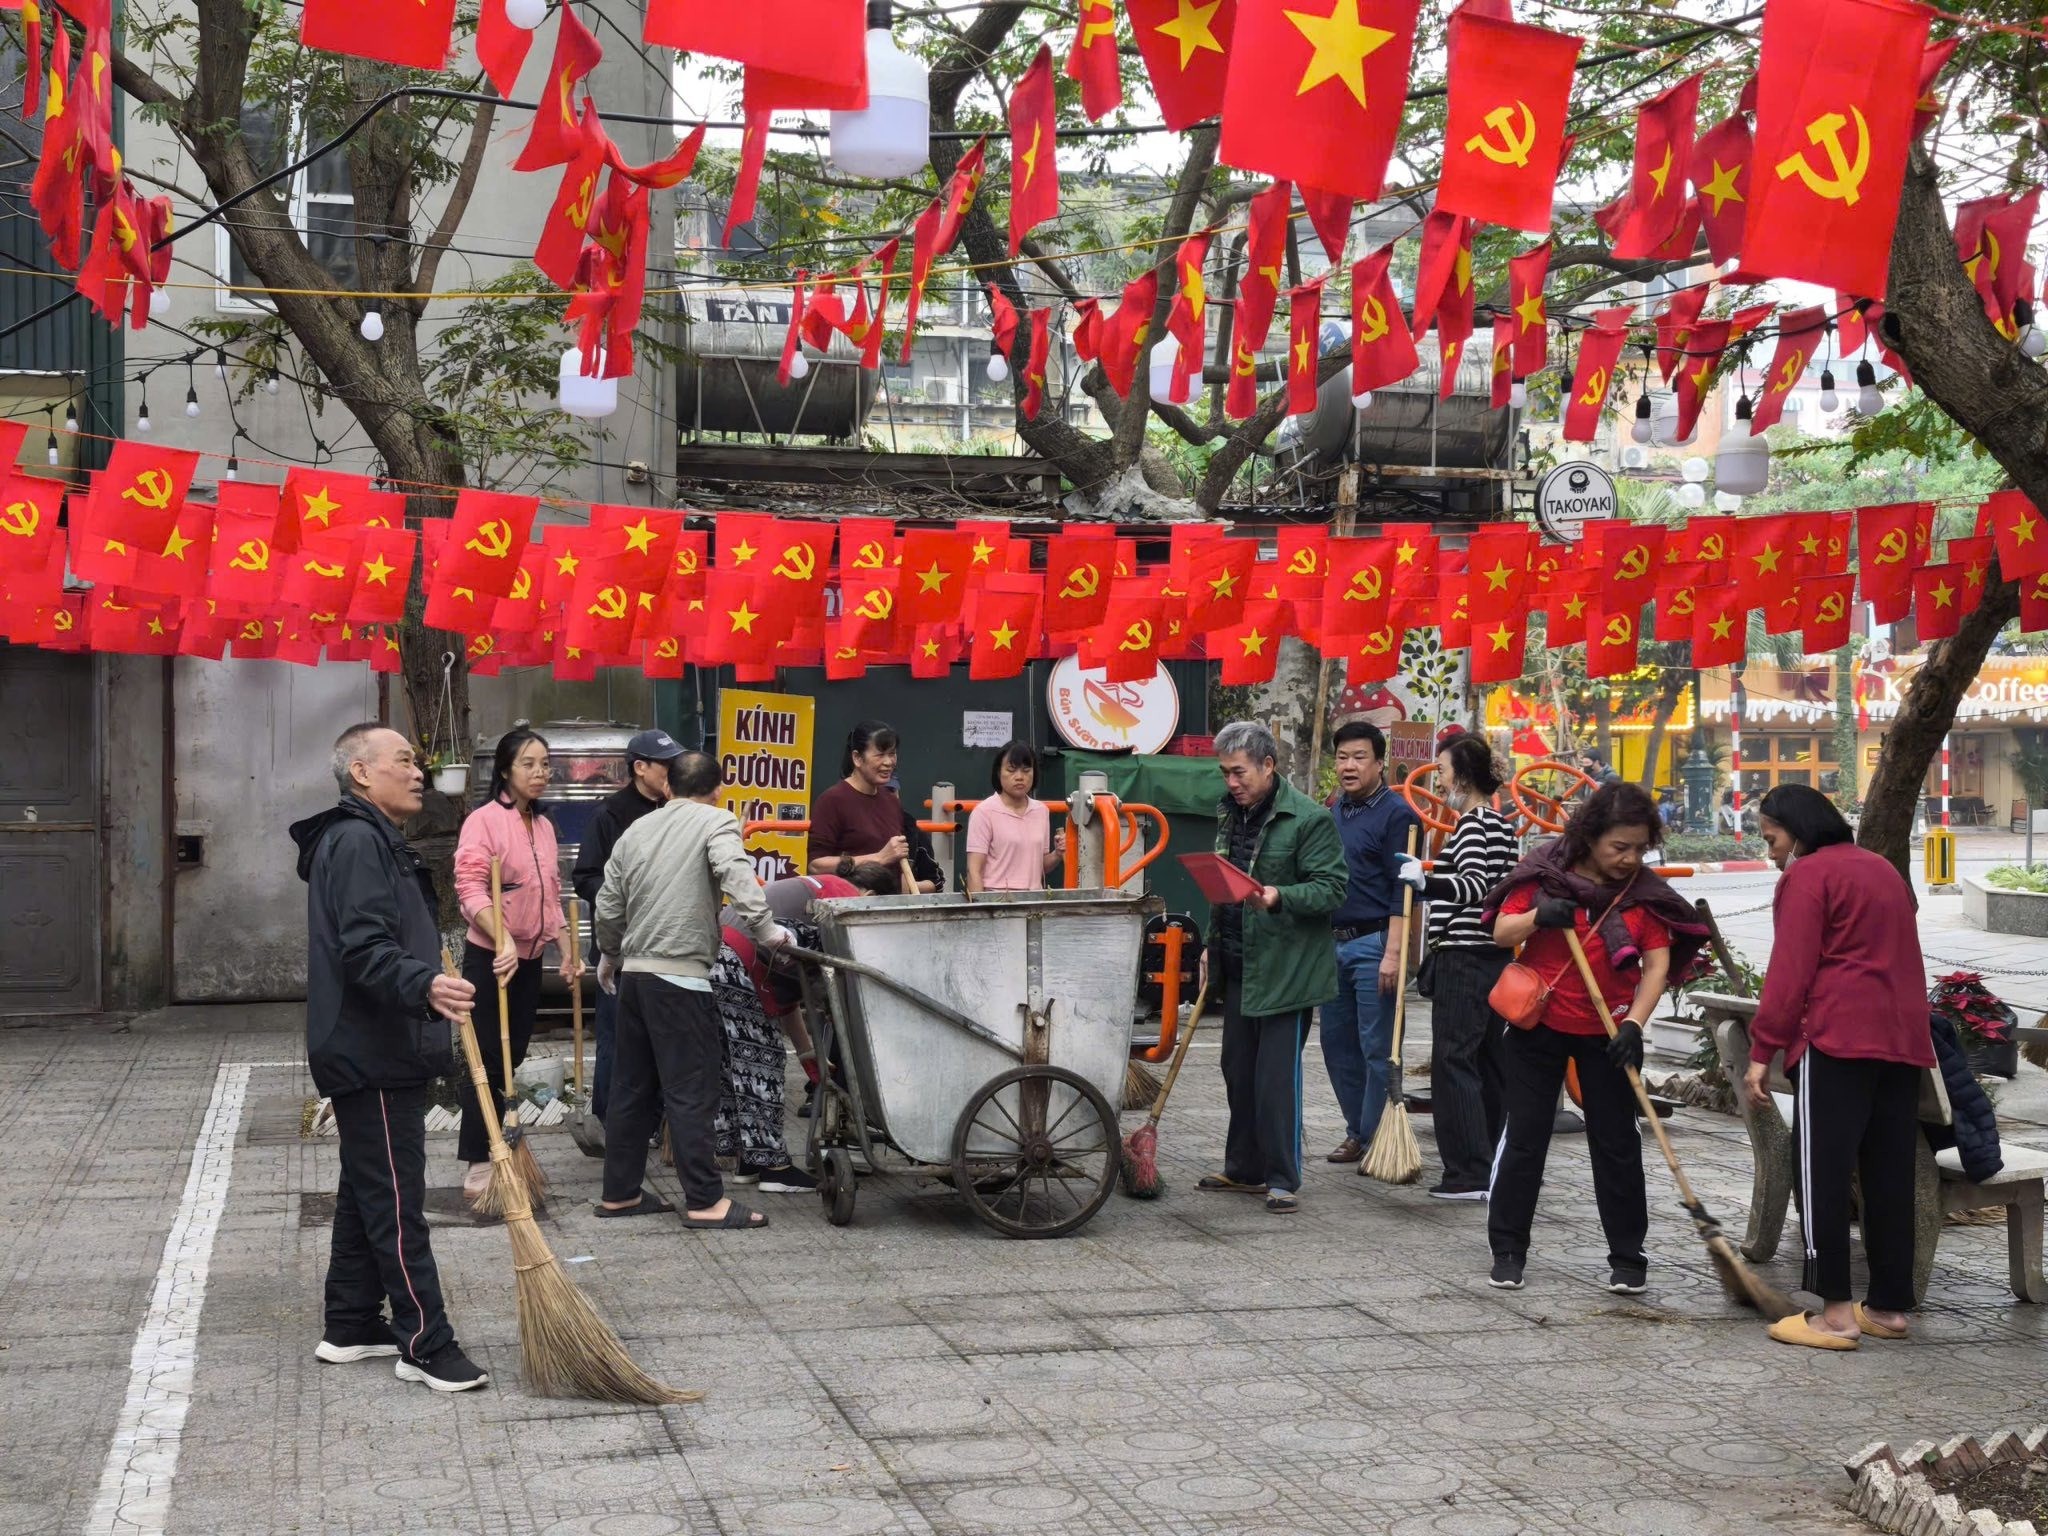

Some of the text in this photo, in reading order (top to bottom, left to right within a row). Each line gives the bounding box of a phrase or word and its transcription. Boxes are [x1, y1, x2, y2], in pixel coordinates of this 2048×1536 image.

[1547, 496, 1611, 515] TAKOYAKI
[1059, 688, 1072, 715] Bún
[736, 703, 796, 745] KÍNH
[721, 748, 806, 791] CƯỜNG
